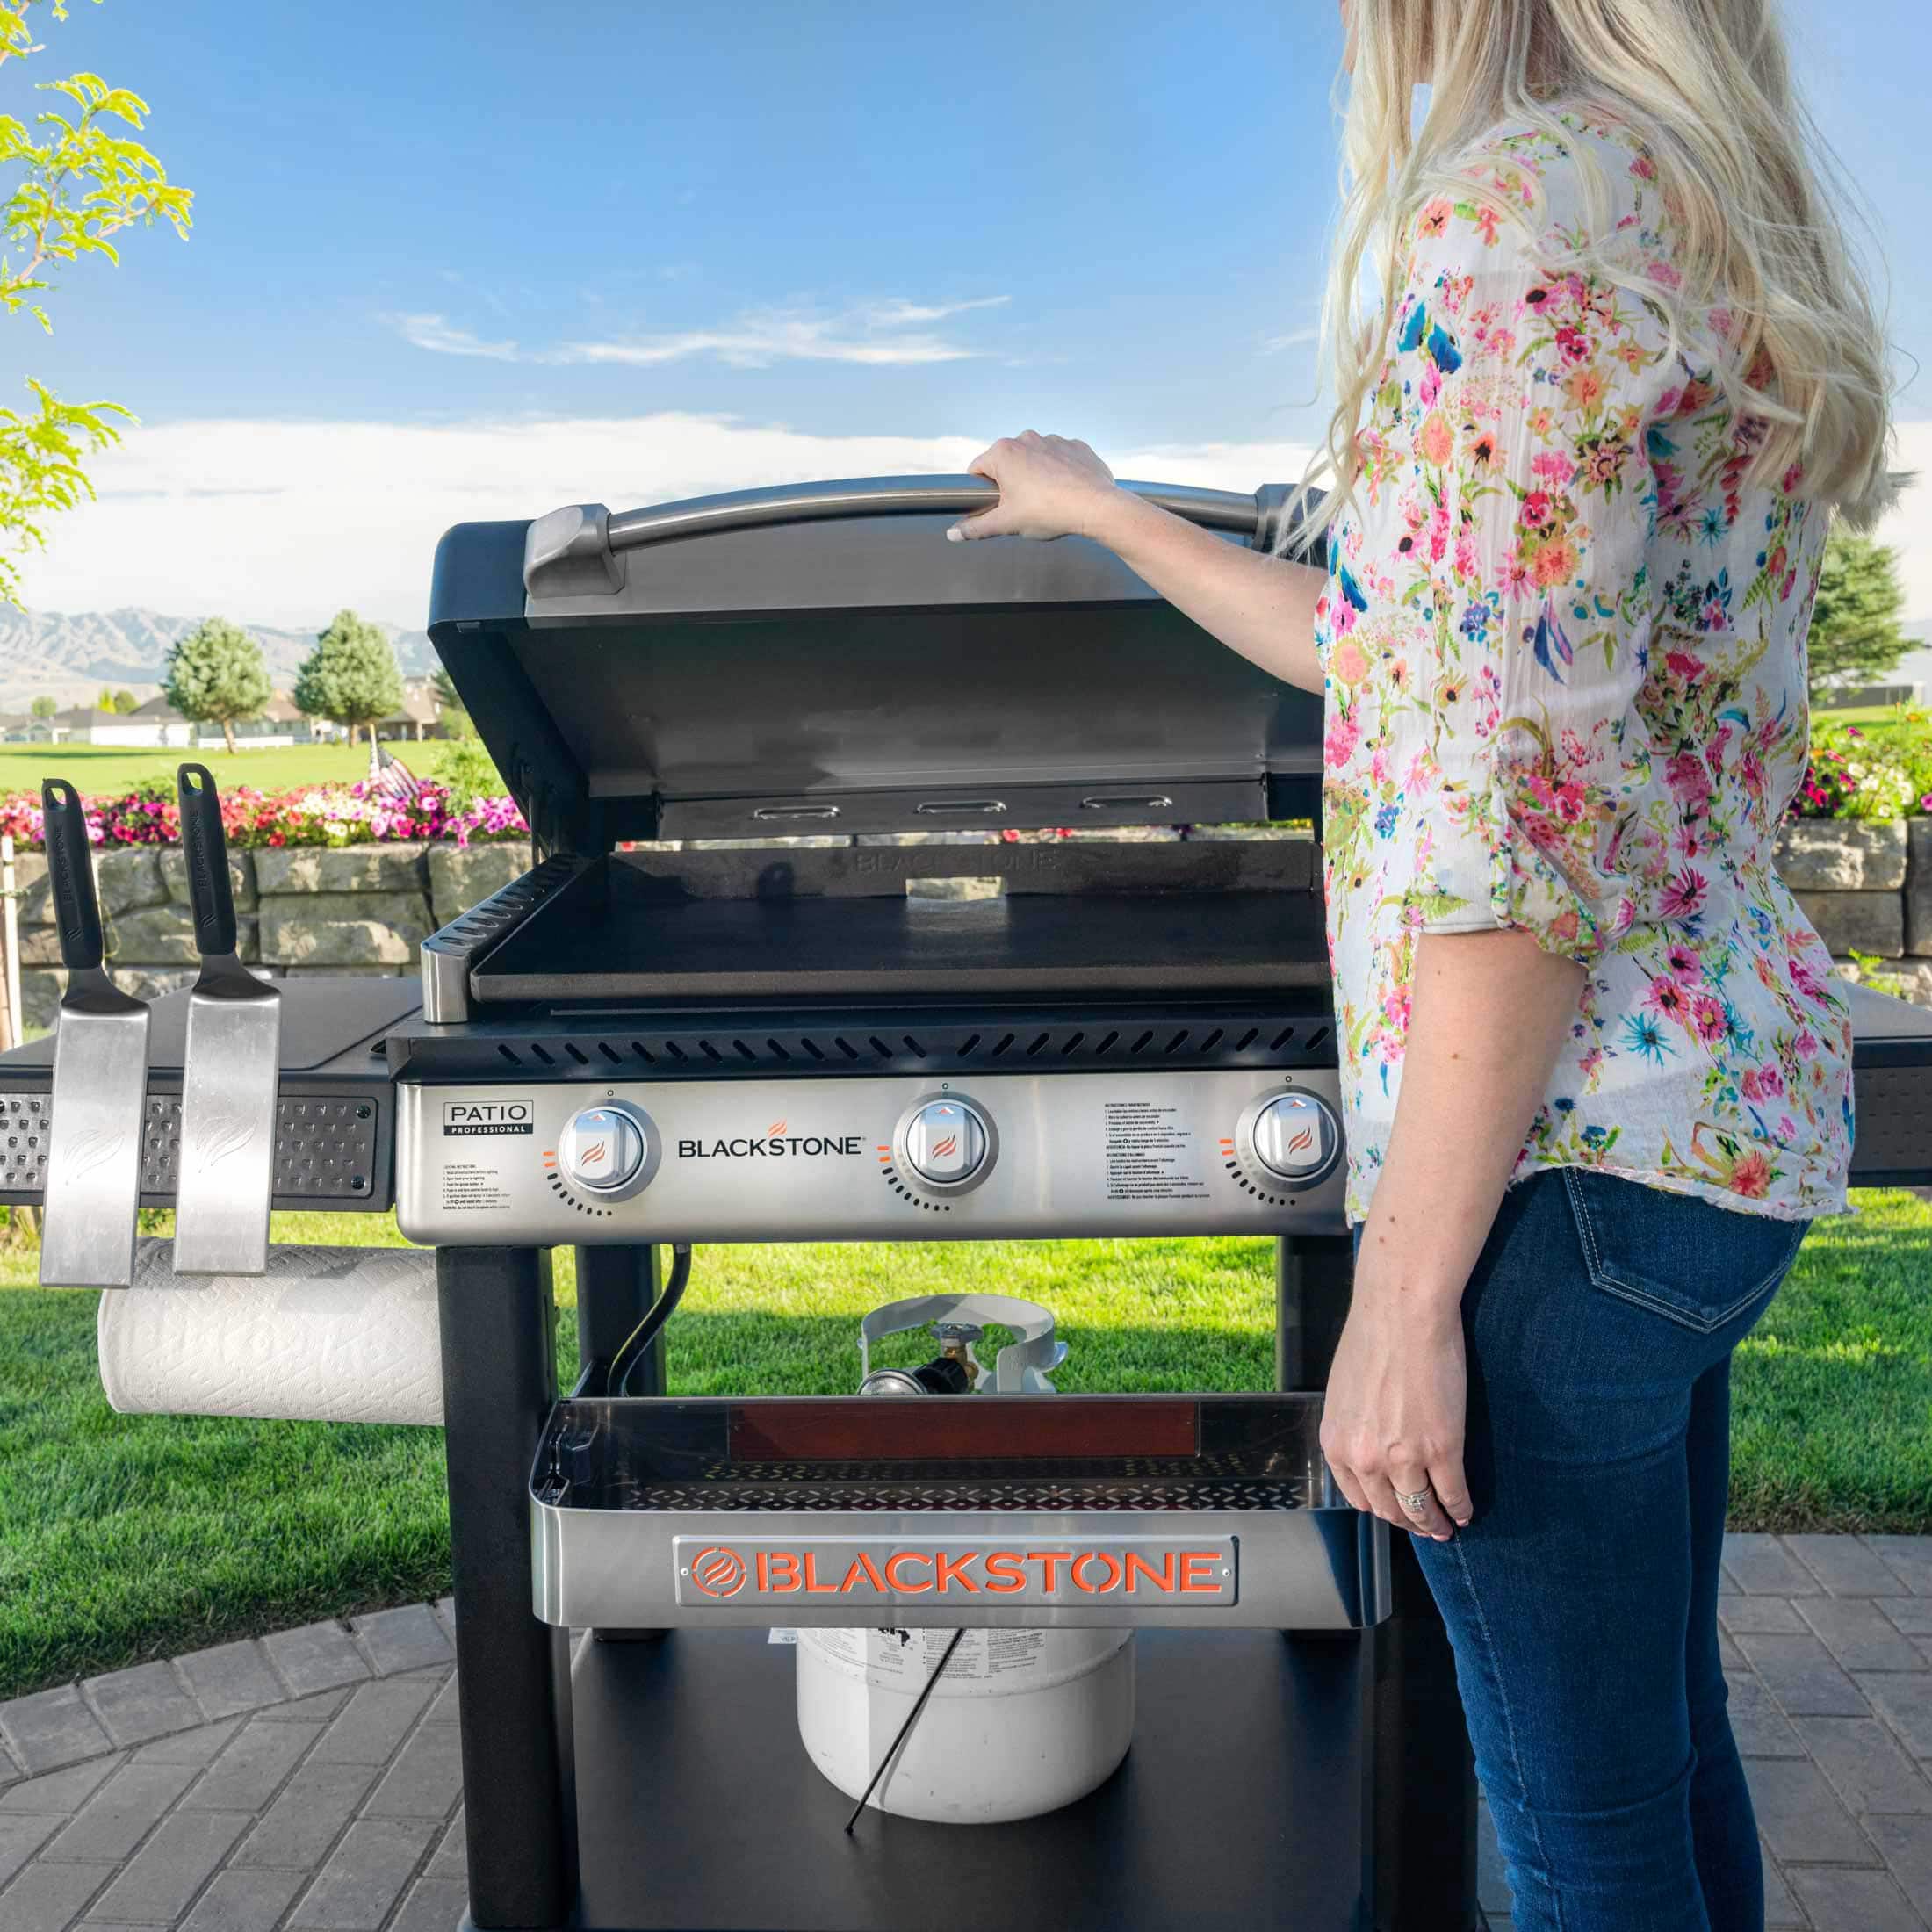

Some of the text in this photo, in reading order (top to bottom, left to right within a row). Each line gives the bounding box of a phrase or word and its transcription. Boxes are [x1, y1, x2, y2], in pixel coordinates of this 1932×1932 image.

[451, 1105, 527, 1121] PATIO
[451, 1126, 526, 1135] PROFESSIONAL
[678, 1136, 861, 1157] BLACKSTONE
[757, 1551, 1223, 1595] BLACKSTONE
